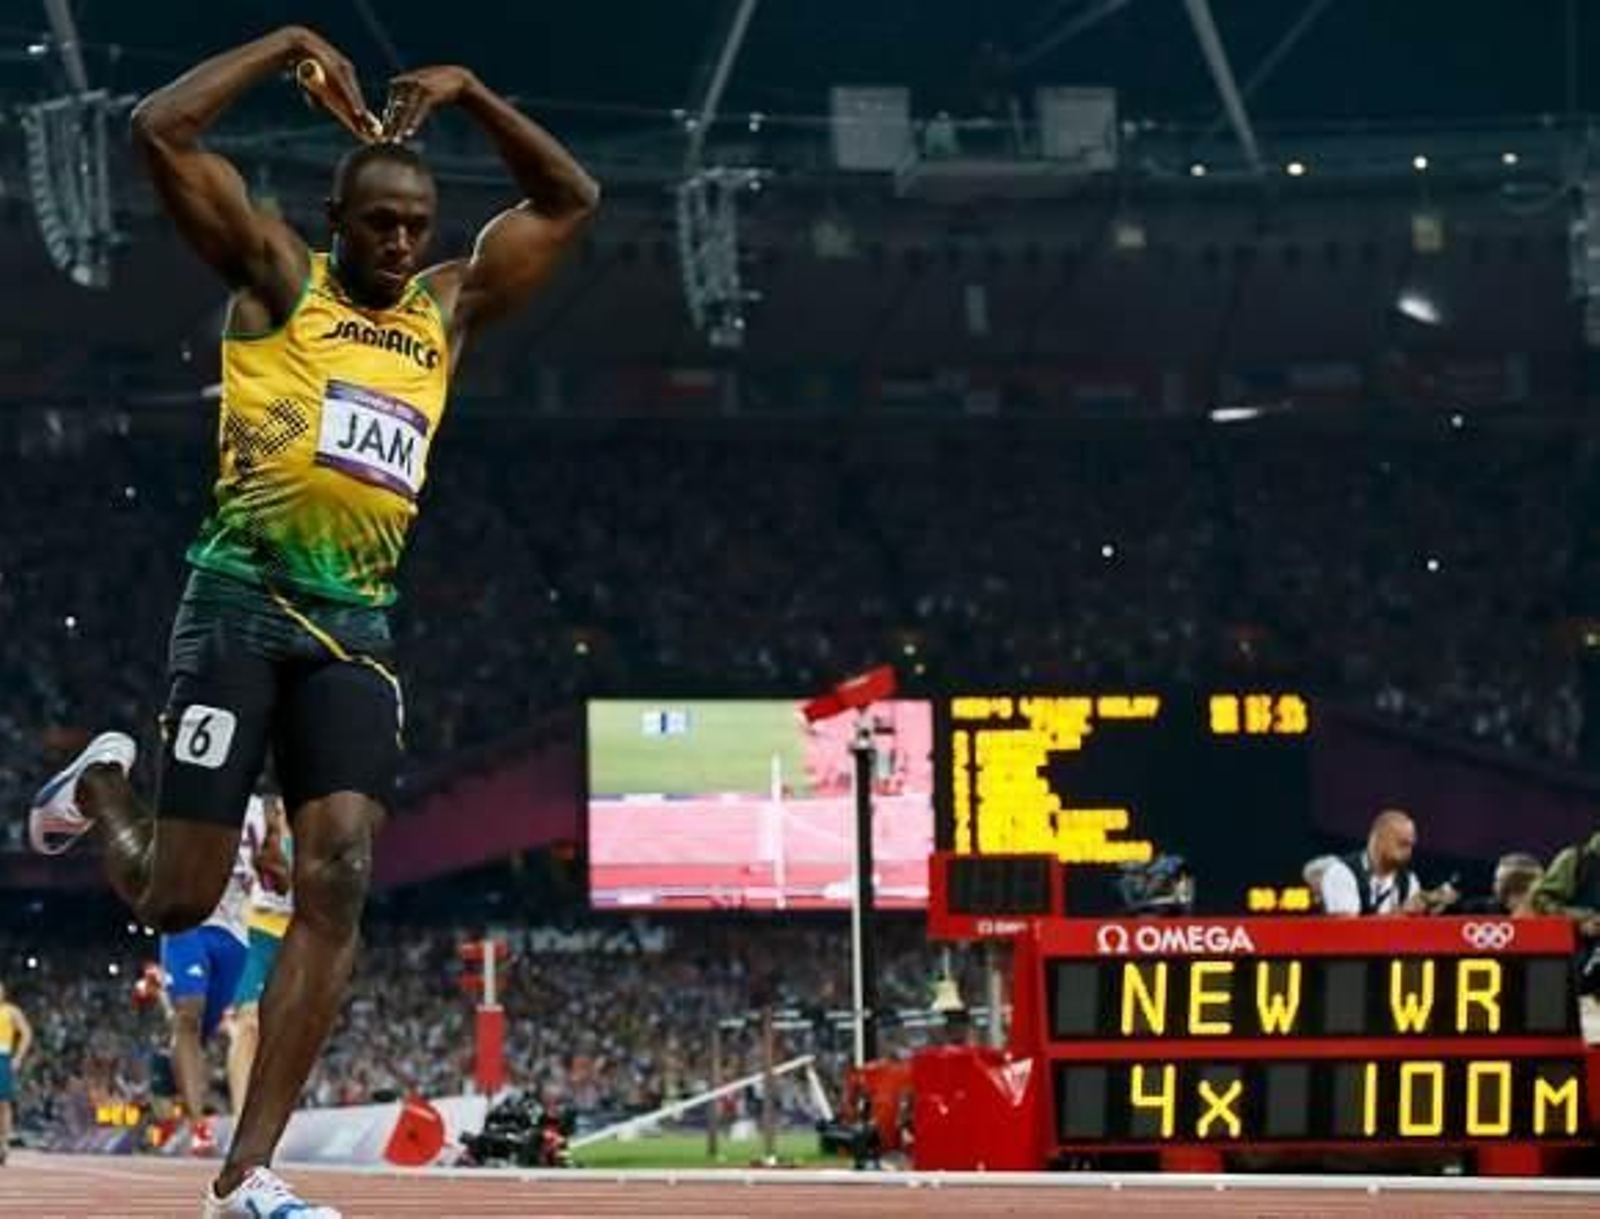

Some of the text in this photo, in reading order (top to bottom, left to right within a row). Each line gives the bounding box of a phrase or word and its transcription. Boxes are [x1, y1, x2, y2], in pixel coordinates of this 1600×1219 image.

[337, 413, 414, 477] JAM
[189, 714, 213, 758] 6
[1135, 926, 1255, 952] OMEGA
[1121, 959, 1501, 1034] NEW WR
